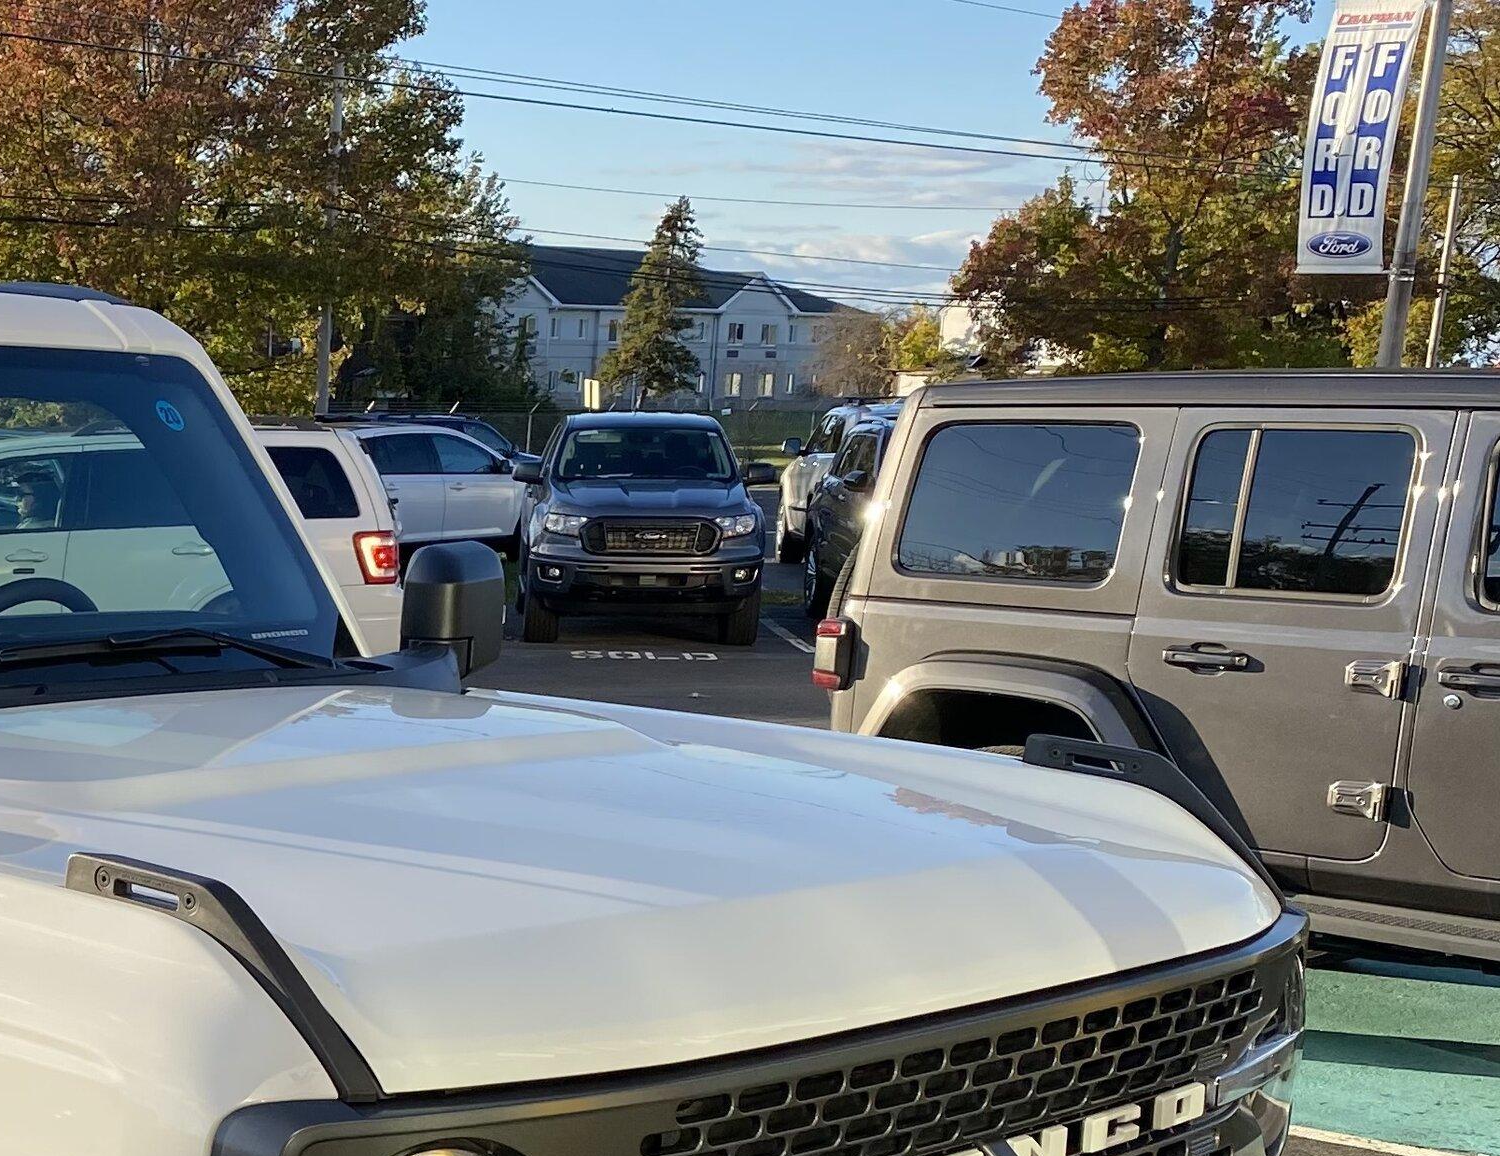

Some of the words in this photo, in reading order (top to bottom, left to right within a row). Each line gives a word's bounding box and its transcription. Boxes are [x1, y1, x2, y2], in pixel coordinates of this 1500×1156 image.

[1337, 11, 1416, 26] CHAPMAN
[1310, 44, 1357, 218] FORD
[1350, 43, 1401, 217] FORD
[1318, 234, 1358, 254] Ford
[251, 629, 309, 640] BRONCO
[570, 650, 719, 661] SOLD
